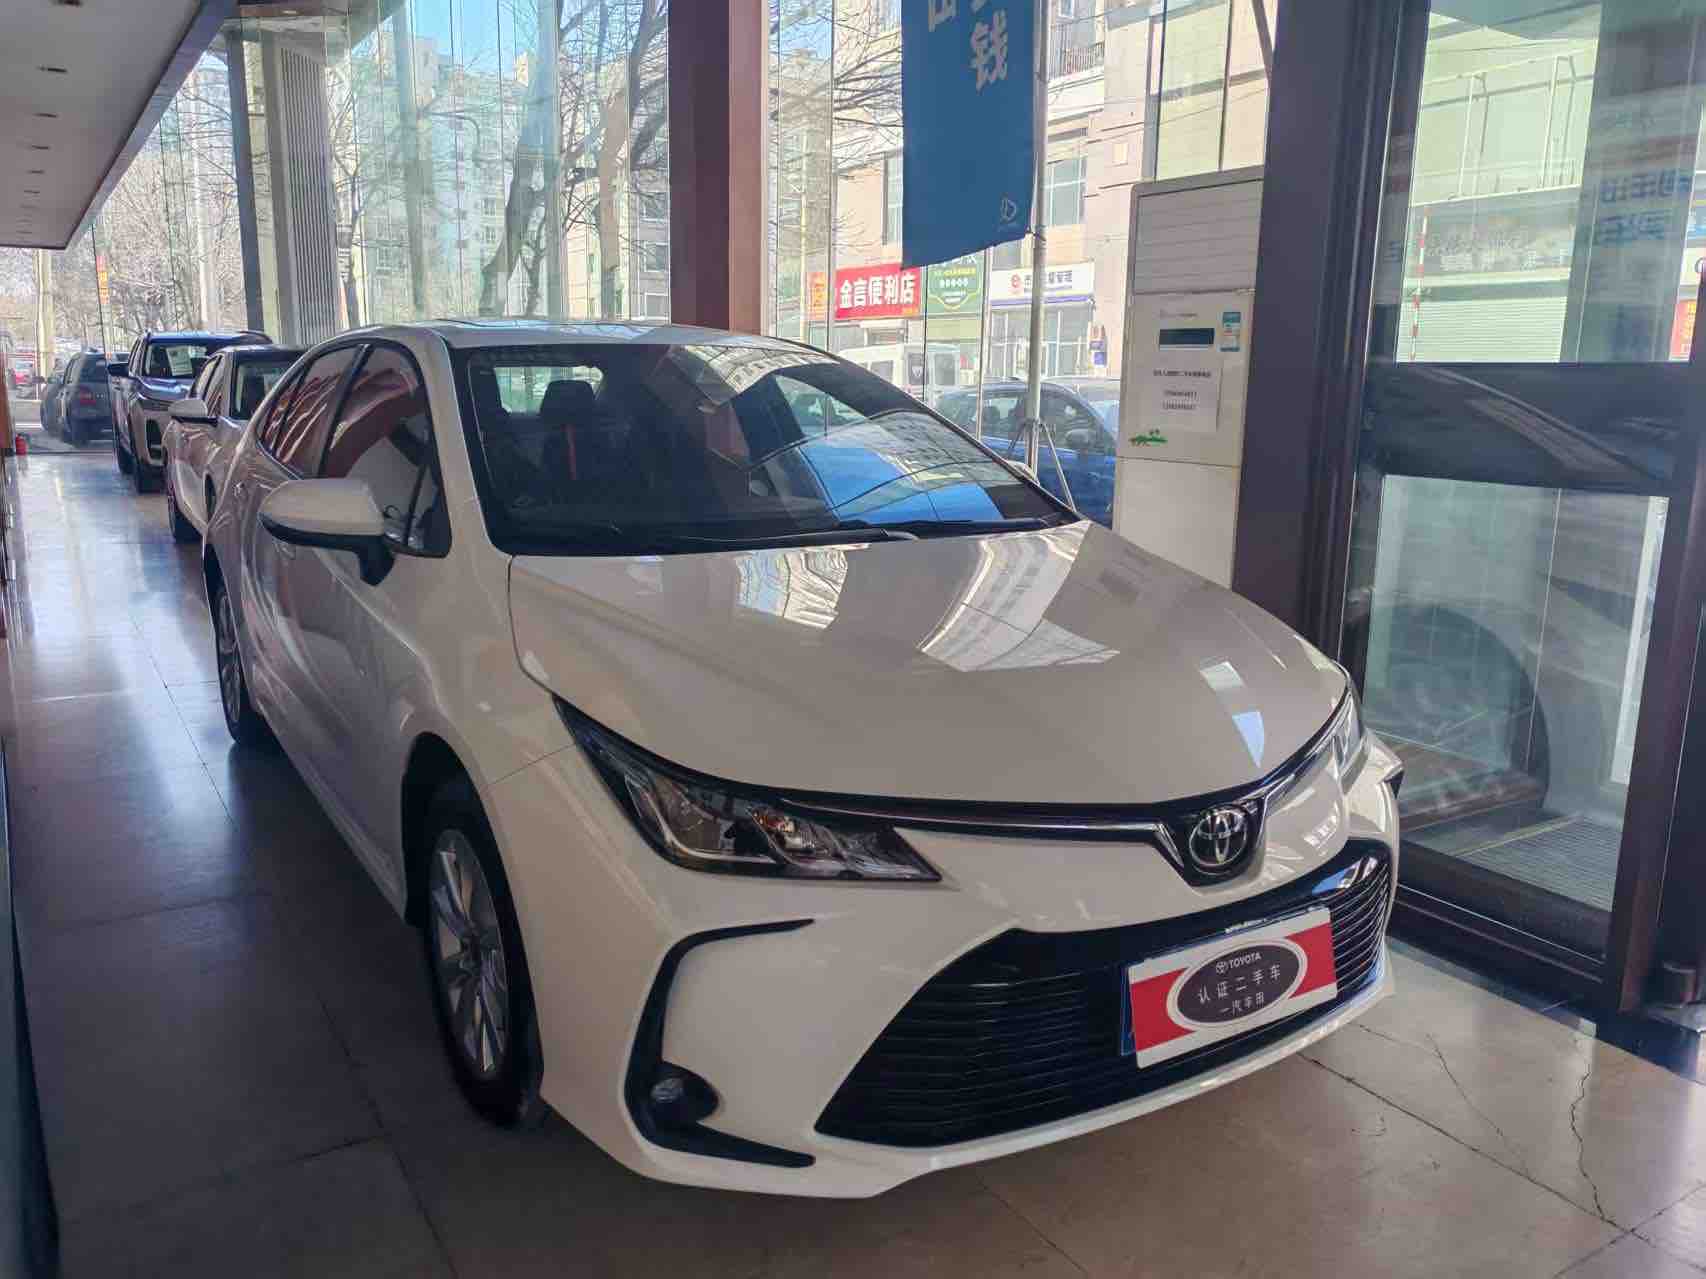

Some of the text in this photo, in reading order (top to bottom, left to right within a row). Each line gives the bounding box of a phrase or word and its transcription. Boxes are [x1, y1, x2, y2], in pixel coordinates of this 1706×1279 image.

[969, 0, 1009, 96] 钱
[1229, 951, 1262, 969] TOYOTA
[1197, 963, 1281, 1005] 认证二手车
